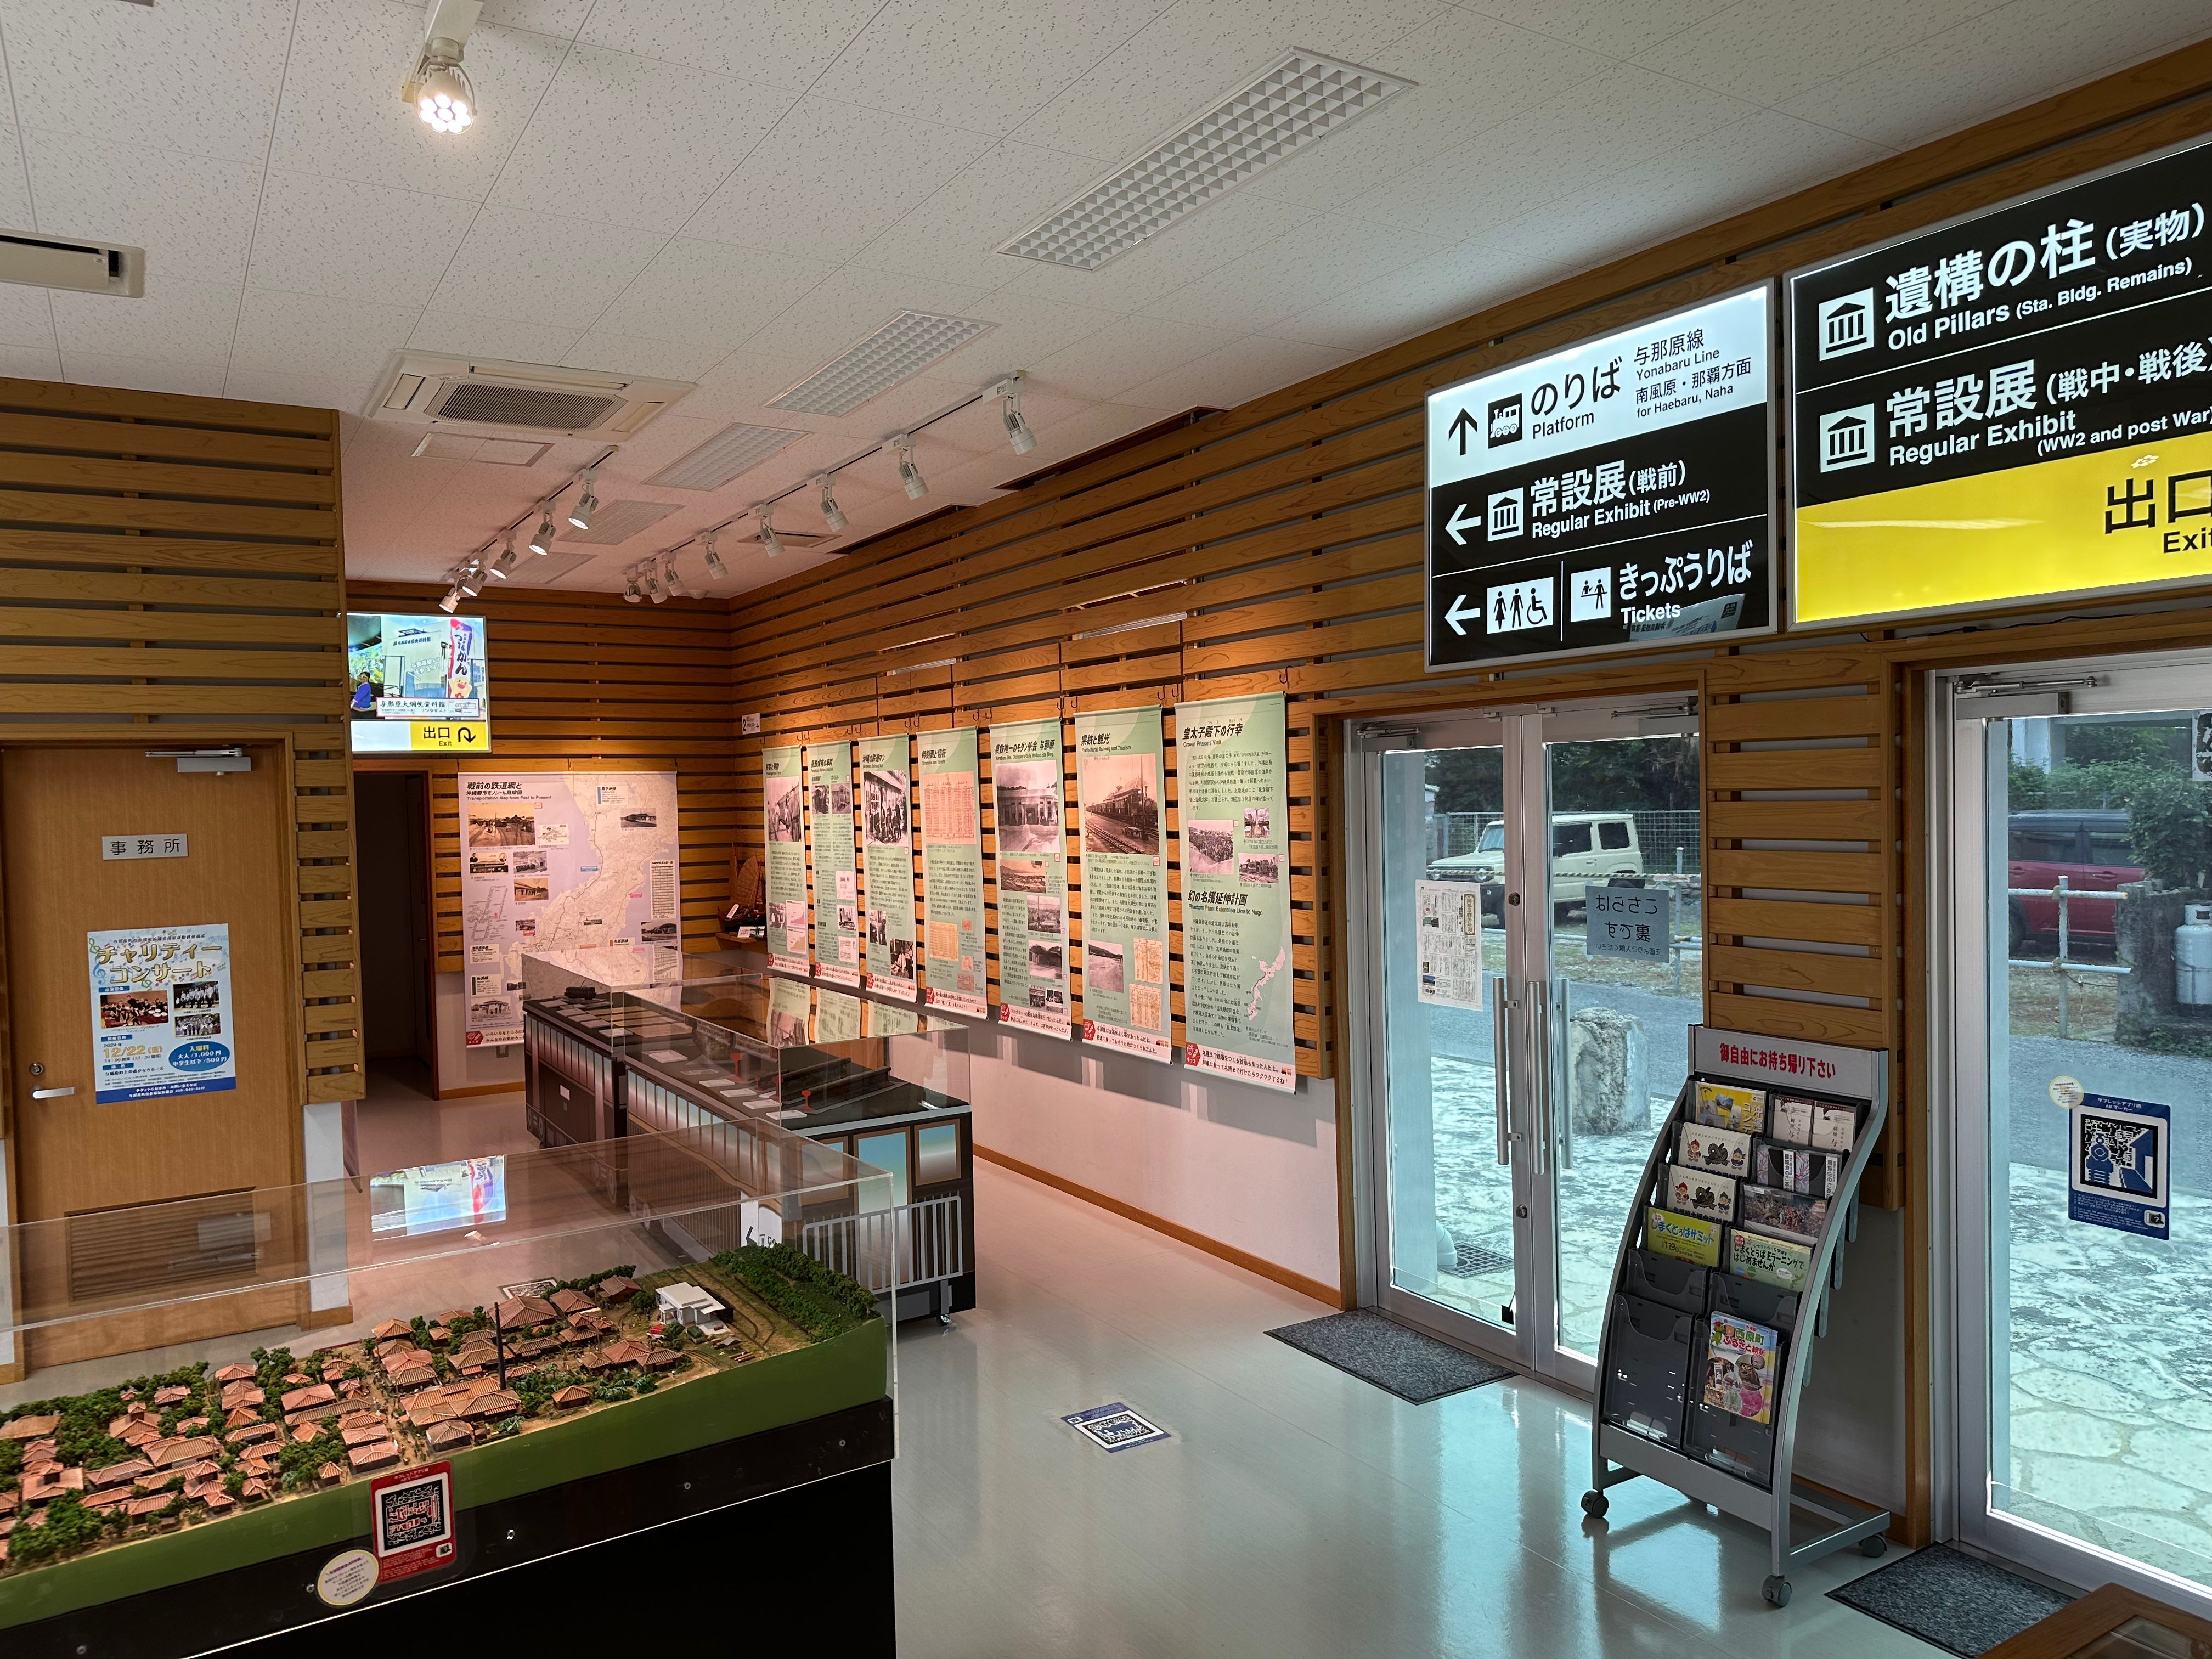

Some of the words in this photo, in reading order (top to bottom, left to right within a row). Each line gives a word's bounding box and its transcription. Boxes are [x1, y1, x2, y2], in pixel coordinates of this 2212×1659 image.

[1888, 324, 1927, 350] Old
[1935, 303, 2010, 338] Pillars
[2016, 296, 2052, 319] (Sta.
[2058, 281, 2101, 306] Bldg.
[2108, 257, 2192, 291] Remains)
[1634, 328, 1704, 365] 与那原線
[1636, 354, 1690, 381] Yonabaru
[1695, 348, 1719, 365] Line
[1531, 357, 1622, 416] のりば
[1635, 357, 1751, 405] 南風原・那覇方面
[1637, 406, 1651, 418] for
[1655, 393, 1702, 414] Haebaru,
[1706, 383, 1733, 400] Naha
[1533, 412, 1594, 439] Platform
[1889, 435, 1979, 466] Regular
[1987, 410, 2076, 445] Exhibit
[2036, 433, 2085, 456] (WW2
[2091, 425, 2122, 442] and
[2128, 417, 2168, 439] post
[1532, 514, 1590, 539] Regular
[1595, 499, 1650, 525] Exhibit
[1654, 489, 1710, 514] (Pre-WW2)
[2105, 470, 2212, 534] 出口
[1620, 539, 1753, 600] きっぷうりば
[1621, 602, 1681, 624] Tickets
[424, 726, 450, 738] 出口
[1081, 733, 1110, 746] 県鉄と観光
[1183, 723, 1243, 740] 皇太子殿下の行幸
[467, 781, 522, 789] 戦前の鉄道網と
[110, 838, 180, 855] 事務所
[1188, 890, 1248, 906] 幻の名護延伸計画
[97, 943, 222, 964] チャリティー
[110, 961, 211, 983] コンサート
[1720, 1043, 1836, 1079] 御自由にお持ち帰り下さい
[2098, 1098, 2141, 1108] タブレットアプリ用
[1734, 1253, 1775, 1271] はじめませんか
[1735, 1328, 1764, 1345] 西原町
